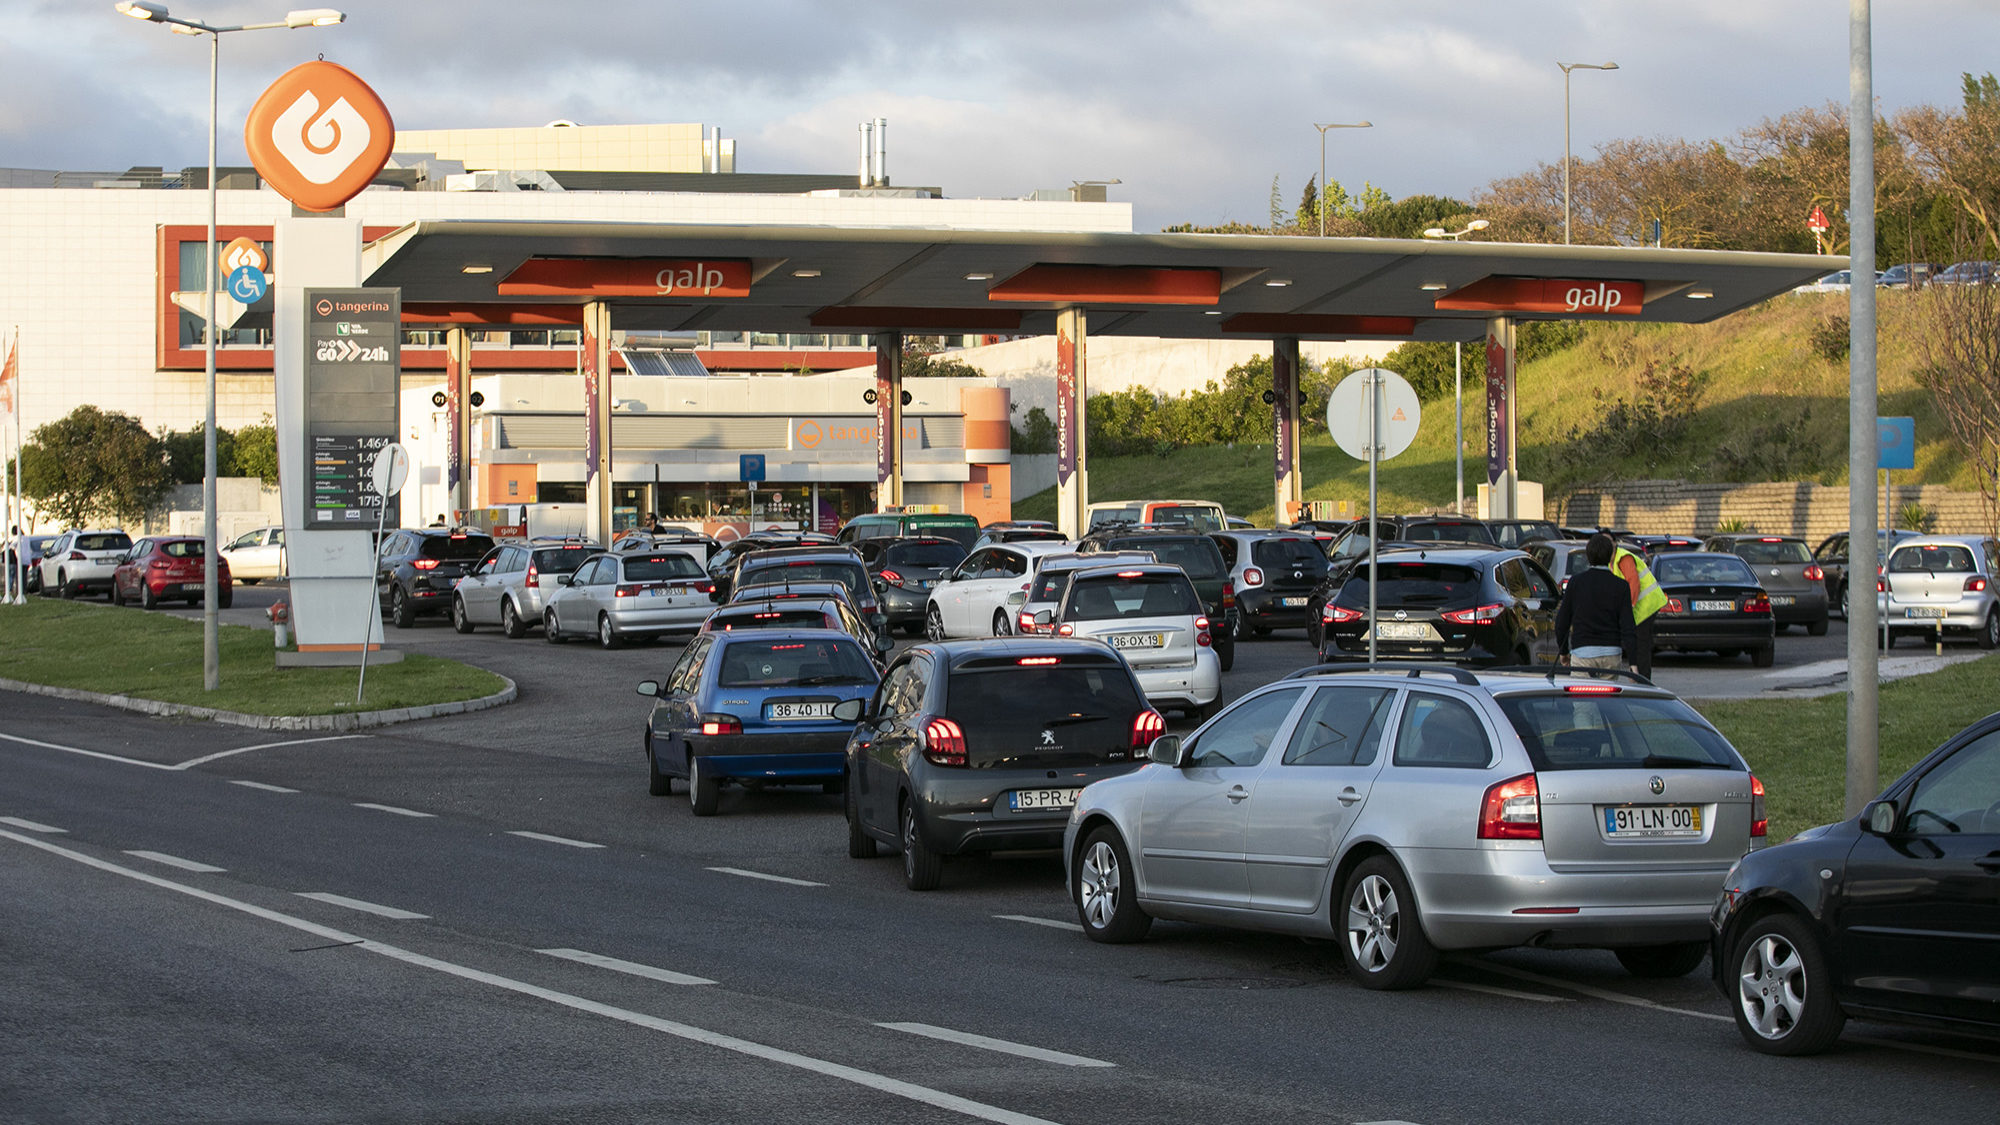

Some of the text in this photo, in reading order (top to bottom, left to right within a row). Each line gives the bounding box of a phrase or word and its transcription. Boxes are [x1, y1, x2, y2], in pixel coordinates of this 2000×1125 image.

[655, 263, 724, 295] galp
[1565, 283, 1622, 312] galp
[335, 301, 389, 313] tangerina
[316, 346, 389, 361] GO 24h
[434, 395, 445, 404] 01
[865, 393, 876, 401] 03
[1059, 396, 1067, 459] evologic
[1275, 407, 1284, 461] evologic
[1489, 399, 1498, 458] evologic
[357, 438, 389, 449] 1.464
[745, 458, 759, 478] P
[501, 527, 518, 535] galp
